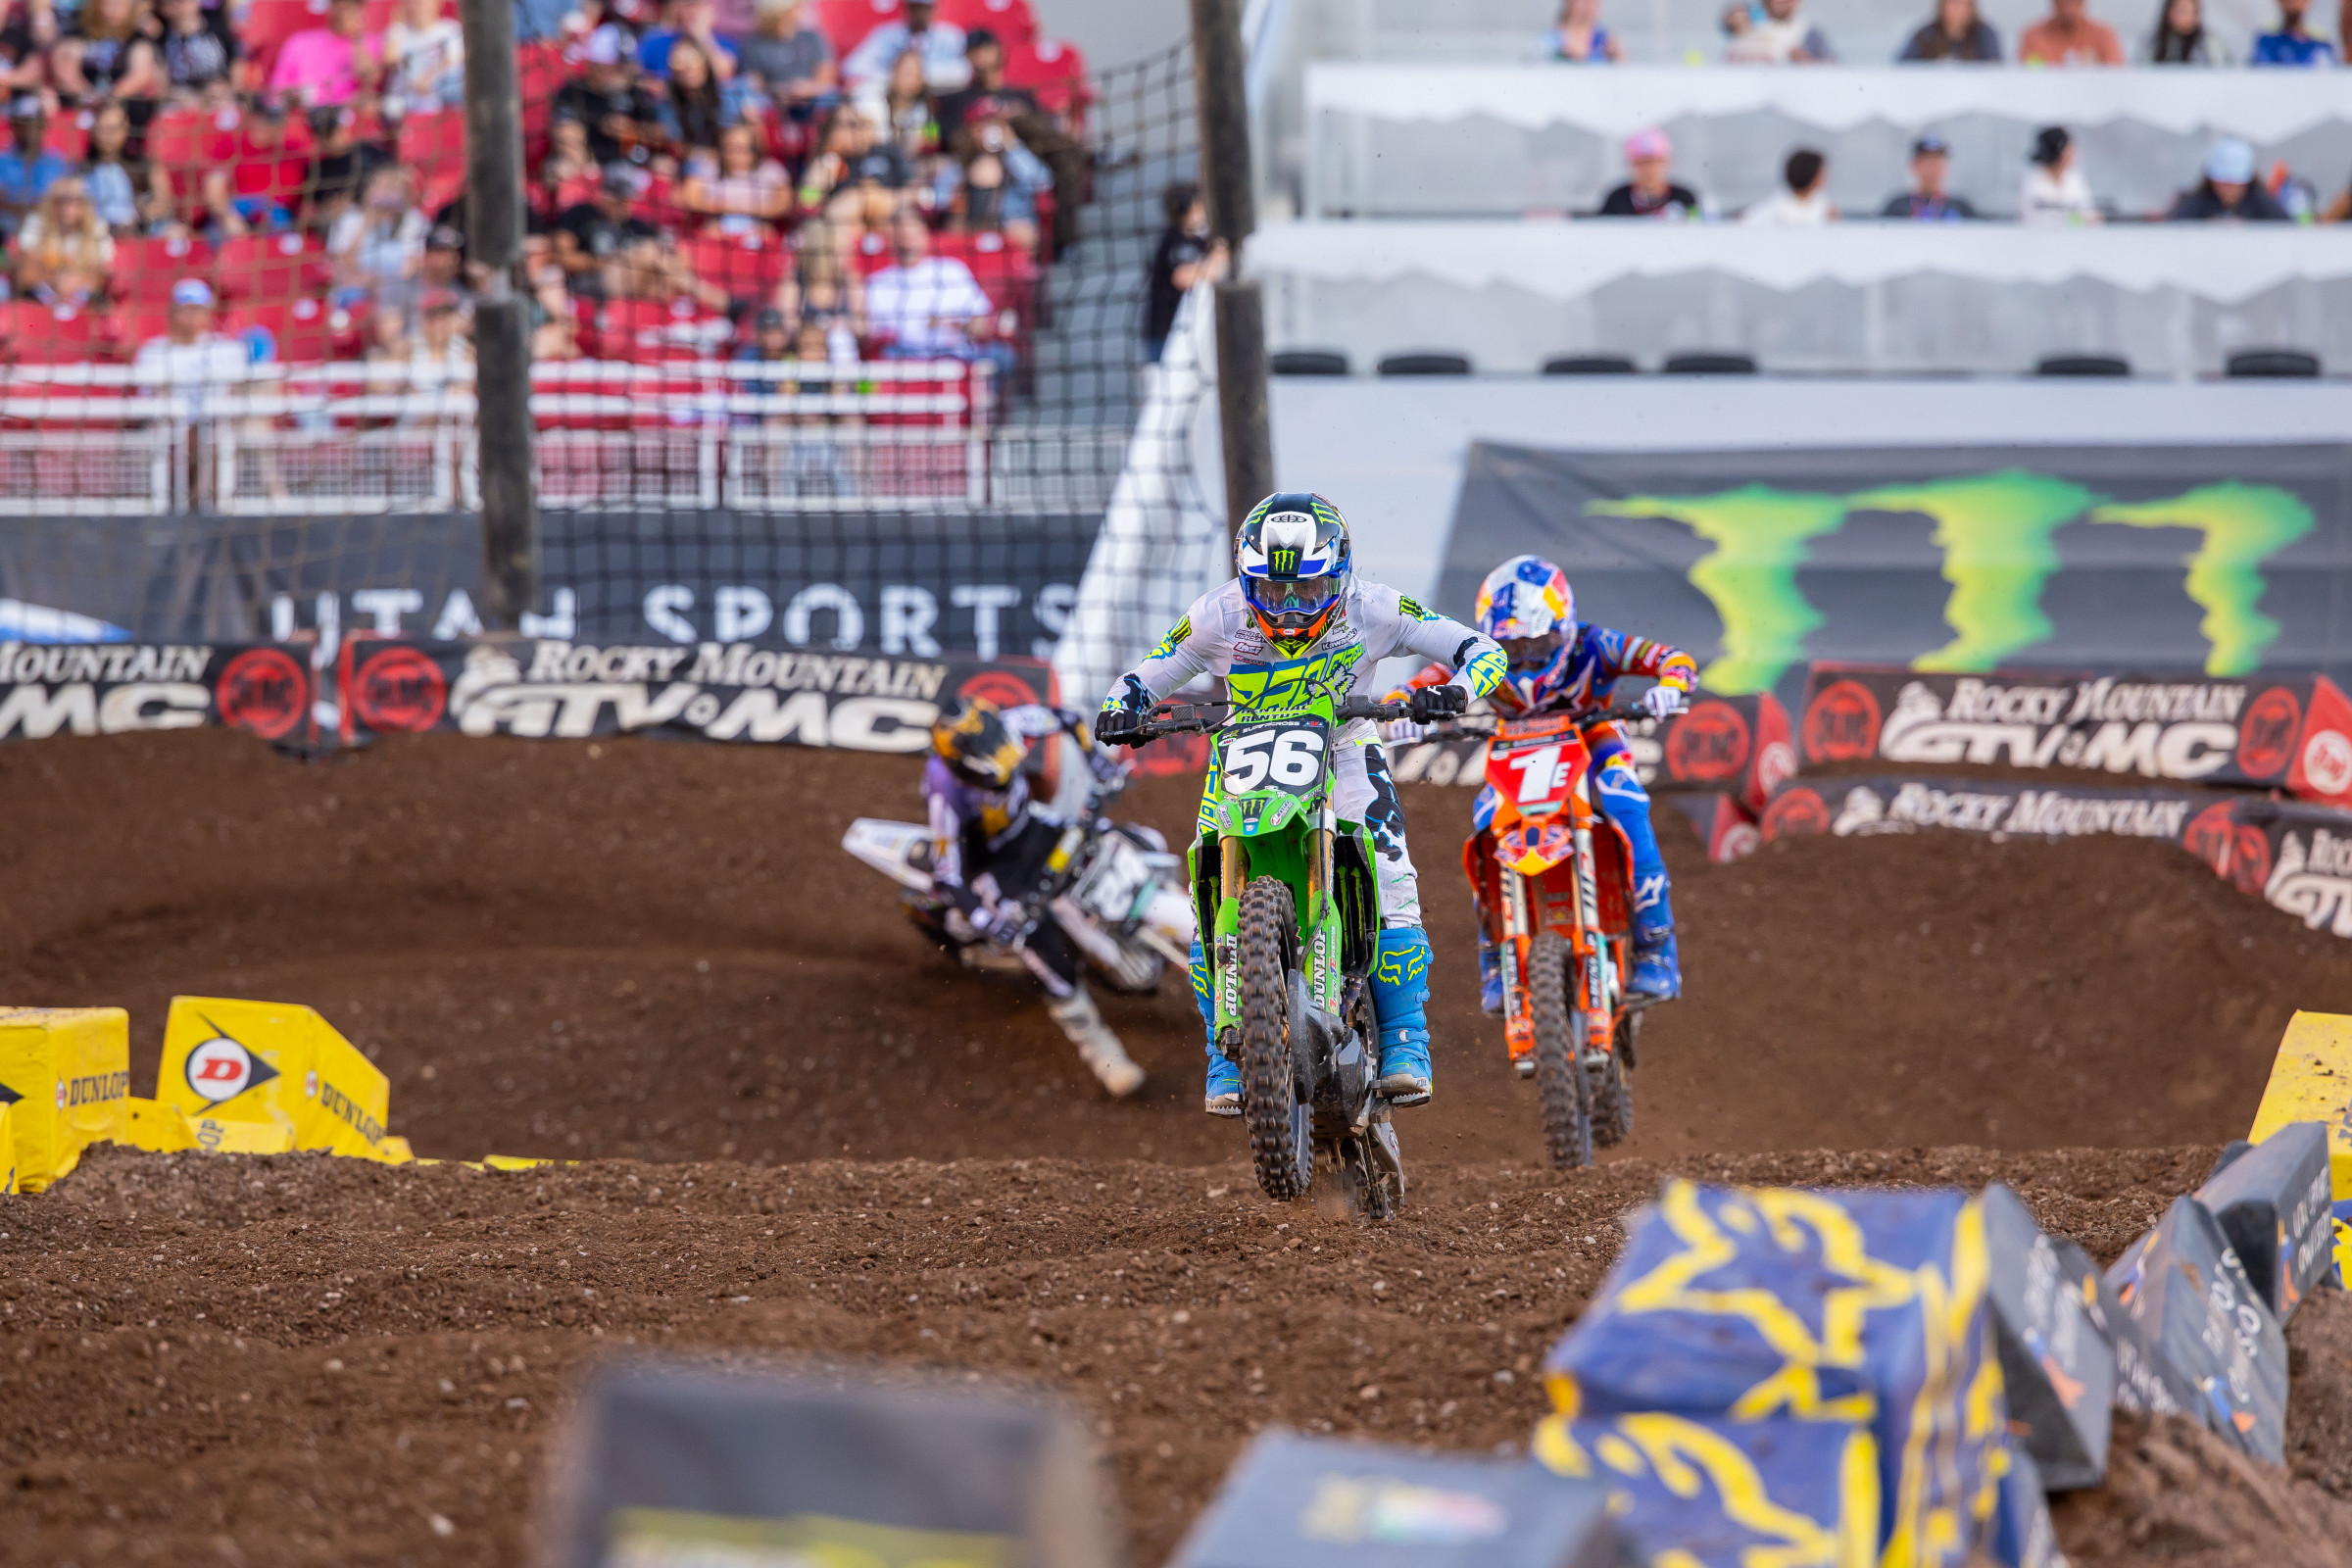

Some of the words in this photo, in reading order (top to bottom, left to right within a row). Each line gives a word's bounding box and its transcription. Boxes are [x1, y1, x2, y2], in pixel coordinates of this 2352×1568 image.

[643, 583, 1075, 662] SPORTS
[528, 641, 686, 683] ROCKY
[684, 642, 949, 700] MOUNTAIN
[0, 682, 211, 740] MC
[1946, 677, 2070, 724] ROCKY
[2065, 676, 2246, 722] MOUNTAIN
[1224, 730, 1324, 795] 56
[1888, 783, 2009, 830] ROCKY
[2003, 790, 2189, 838] MOUNTAIN
[70, 1070, 128, 1105] DUNLOP
[196, 1058, 243, 1080] D
[321, 1082, 384, 1146] DUNLOP
